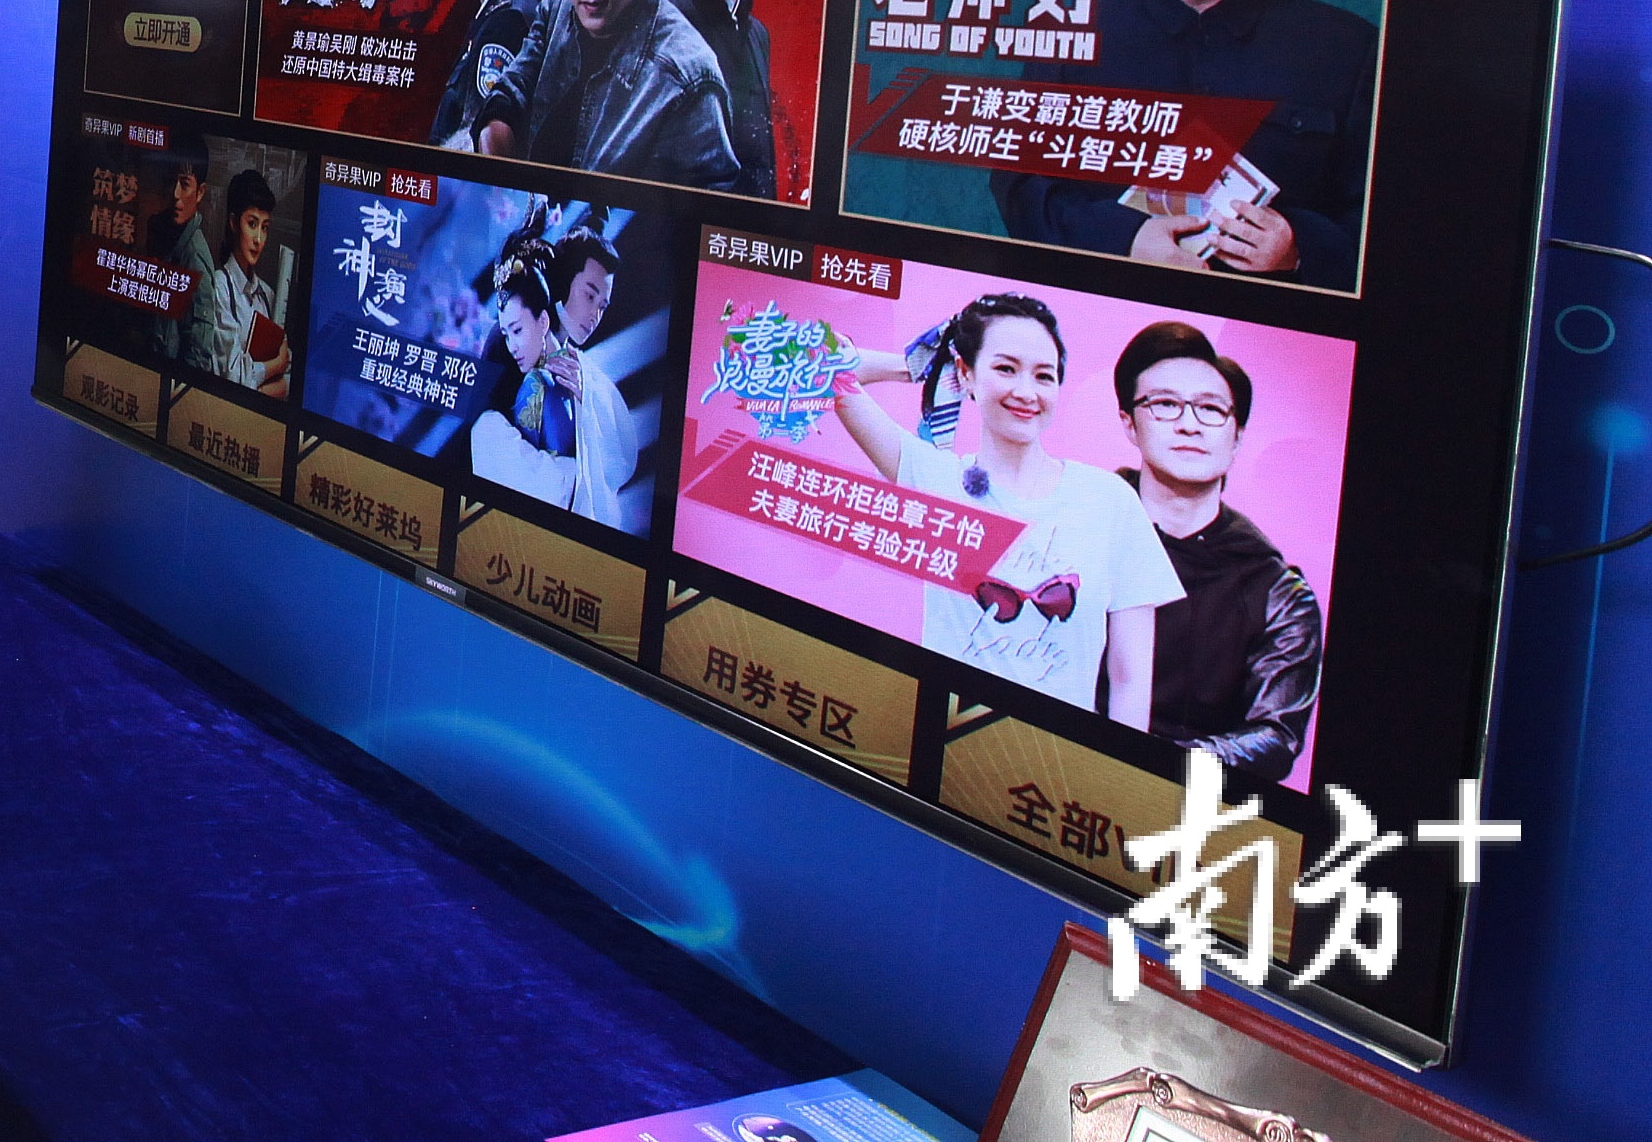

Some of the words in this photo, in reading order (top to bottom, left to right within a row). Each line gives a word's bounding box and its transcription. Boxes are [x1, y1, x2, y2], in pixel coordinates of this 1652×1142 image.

[133, 16, 191, 48] 立即开通
[291, 30, 357, 55] 黄景瑜吴刚
[360, 37, 418, 62] 破冰出击
[869, 21, 942, 52] SONG
[950, 25, 986, 55] OF
[995, 27, 1096, 61] YOUTH
[280, 54, 416, 89] 还原中国特大缉毒案件
[85, 116, 123, 137] 奇异果VIP
[128, 125, 165, 147] 新剧首播
[940, 84, 1183, 137] 于谦变霸道教师
[325, 162, 382, 188] 奇异果VIP
[391, 173, 432, 201] 抢先看
[707, 233, 804, 271] 奇异果VIP
[820, 252, 893, 292] 抢先看
[107, 273, 172, 311] 上演爱恨纠葛
[727, 300, 827, 354] 妻子的
[352, 328, 400, 361] 王丽坤
[404, 344, 438, 374] 罗晋
[441, 355, 478, 387] 邓伦
[359, 358, 459, 410] 重现经典神话
[700, 346, 861, 422] 浪漫旅行
[80, 373, 140, 424] 观影记录
[188, 420, 261, 478] 最近热播
[757, 412, 810, 444] 第二季
[308, 472, 422, 550] 精彩好莱坞
[748, 451, 986, 551] 汪峰连环拒绝章子怡
[749, 490, 959, 581] 夫妻旅行考验升级
[486, 551, 603, 633] 少儿动画
[702, 646, 859, 749] 用券专区
